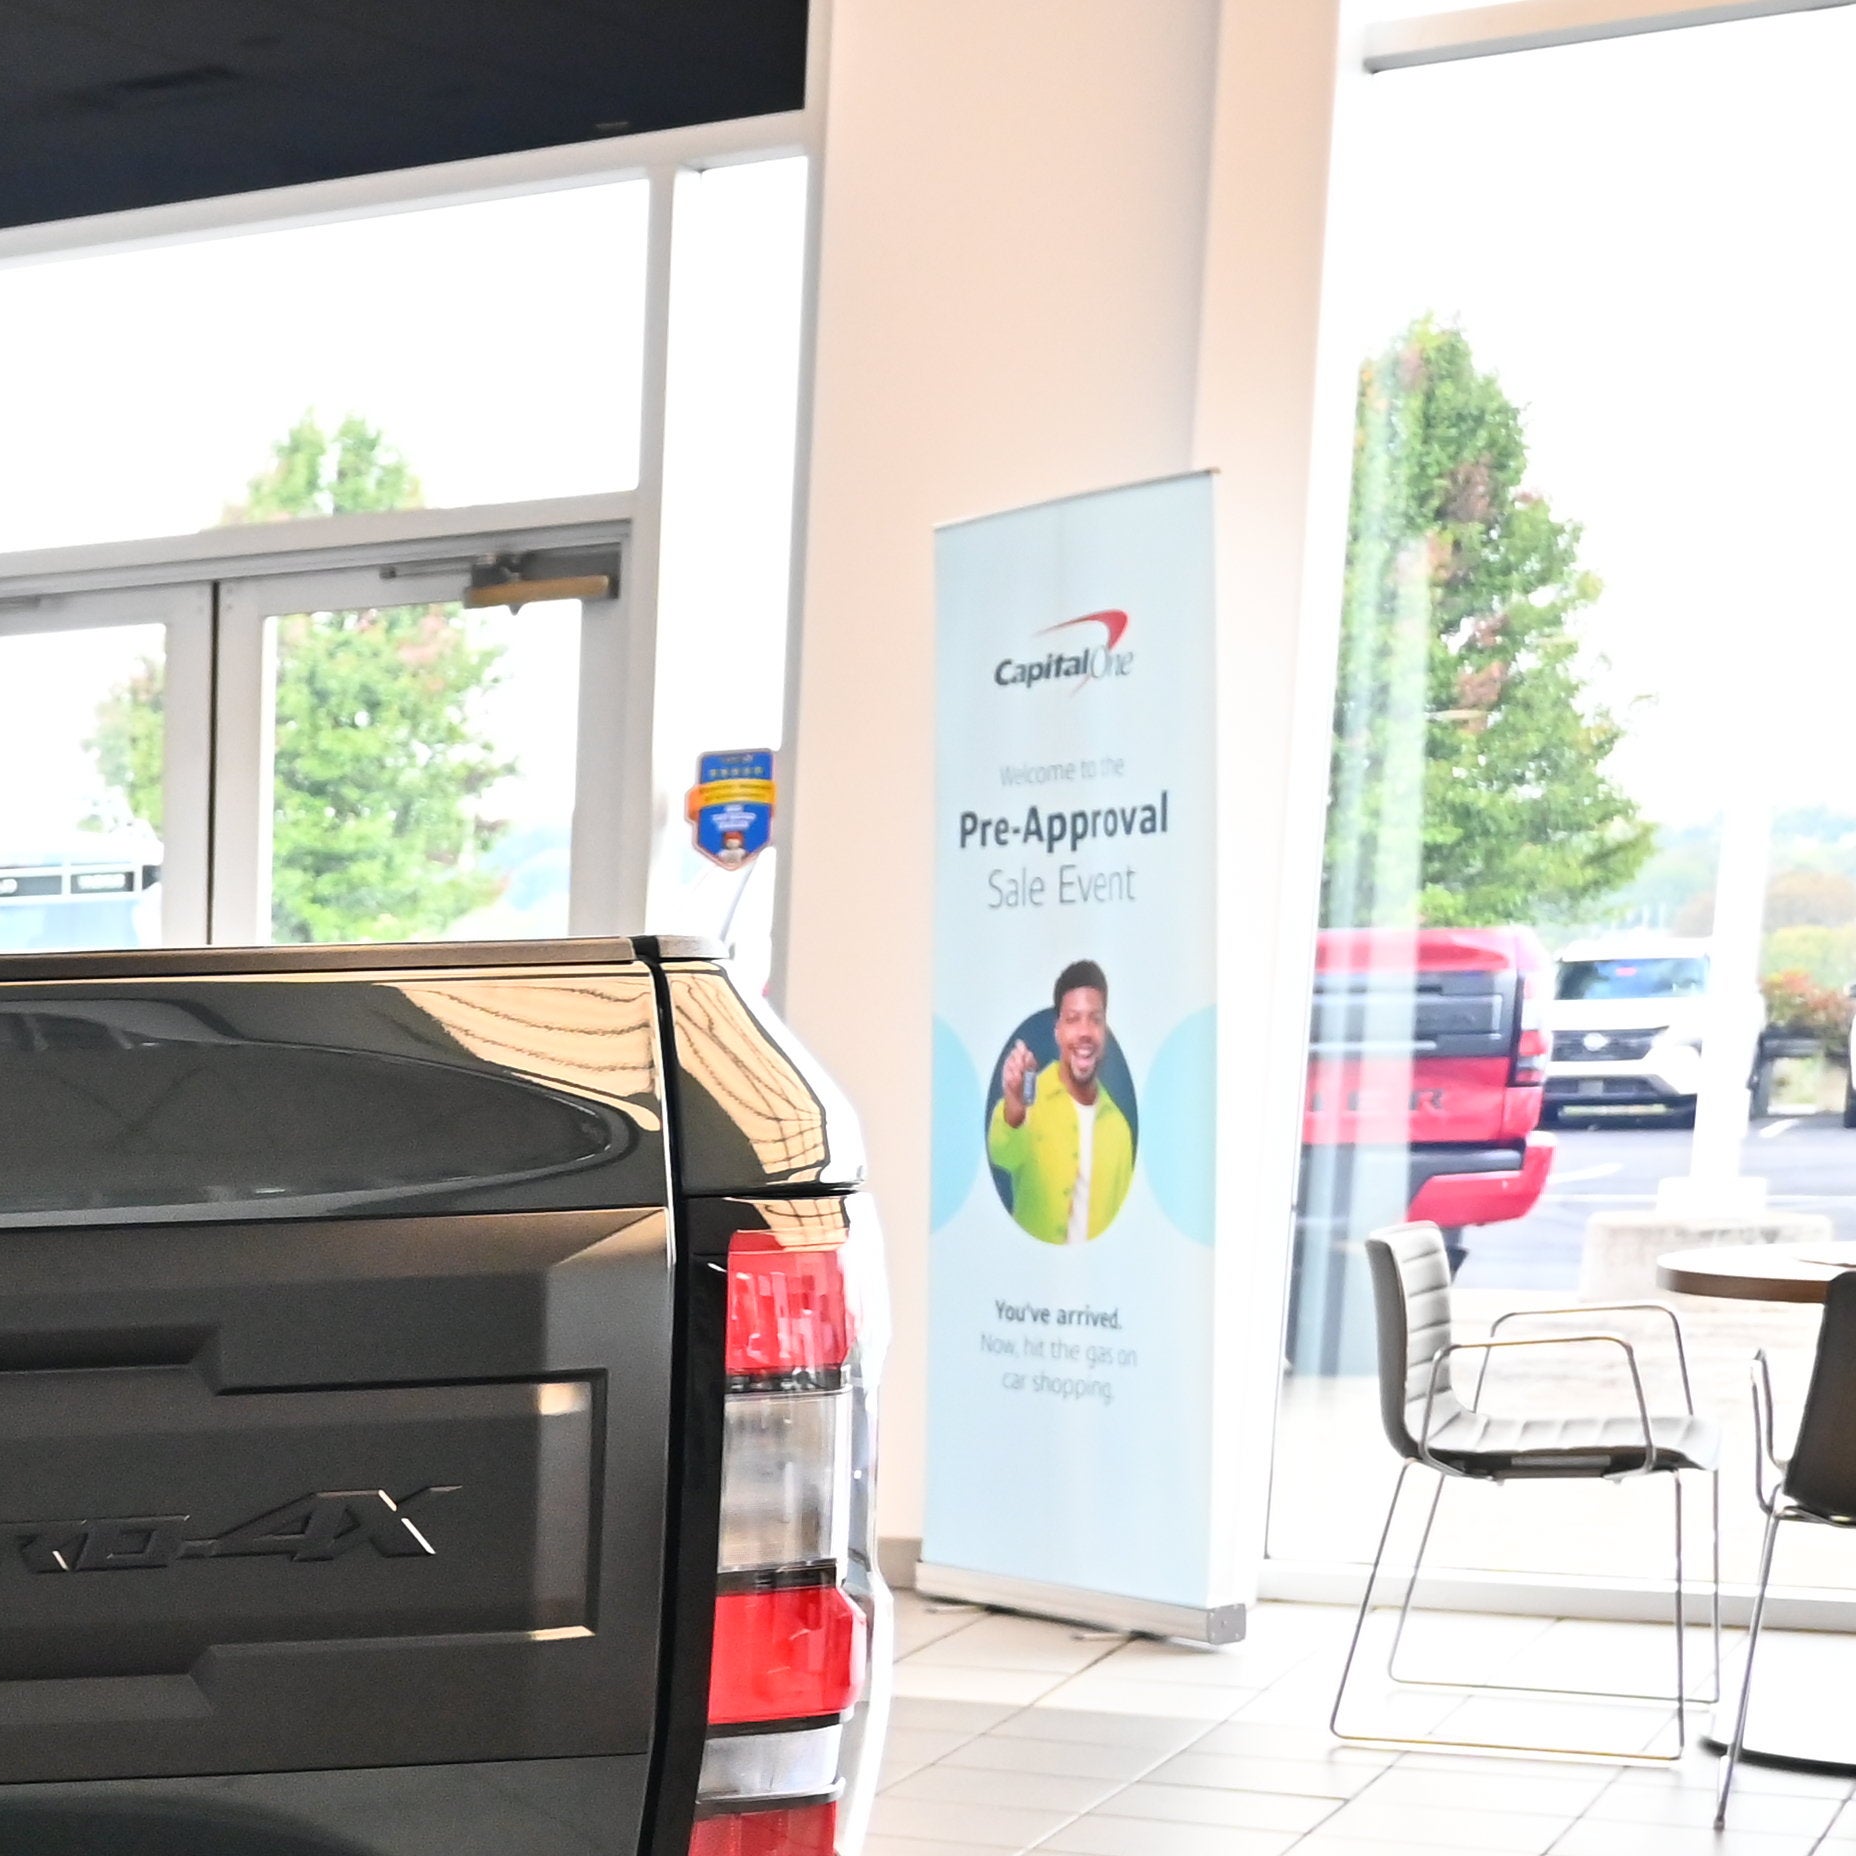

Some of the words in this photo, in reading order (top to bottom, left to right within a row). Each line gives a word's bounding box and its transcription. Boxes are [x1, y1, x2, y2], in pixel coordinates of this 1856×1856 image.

[999, 760, 1076, 787] Welcome
[1081, 757, 1097, 779] to
[1101, 754, 1125, 778] the
[959, 790, 1169, 854] Pre-Approval
[988, 866, 1046, 909] Sale
[1058, 863, 1136, 905] Event
[994, 1299, 1051, 1325] You've
[1056, 1304, 1122, 1330] arrived.
[1050, 1337, 1080, 1361] the
[1085, 1344, 1114, 1370] gas
[1117, 1347, 1138, 1367] on
[1001, 1371, 1027, 1391] car
